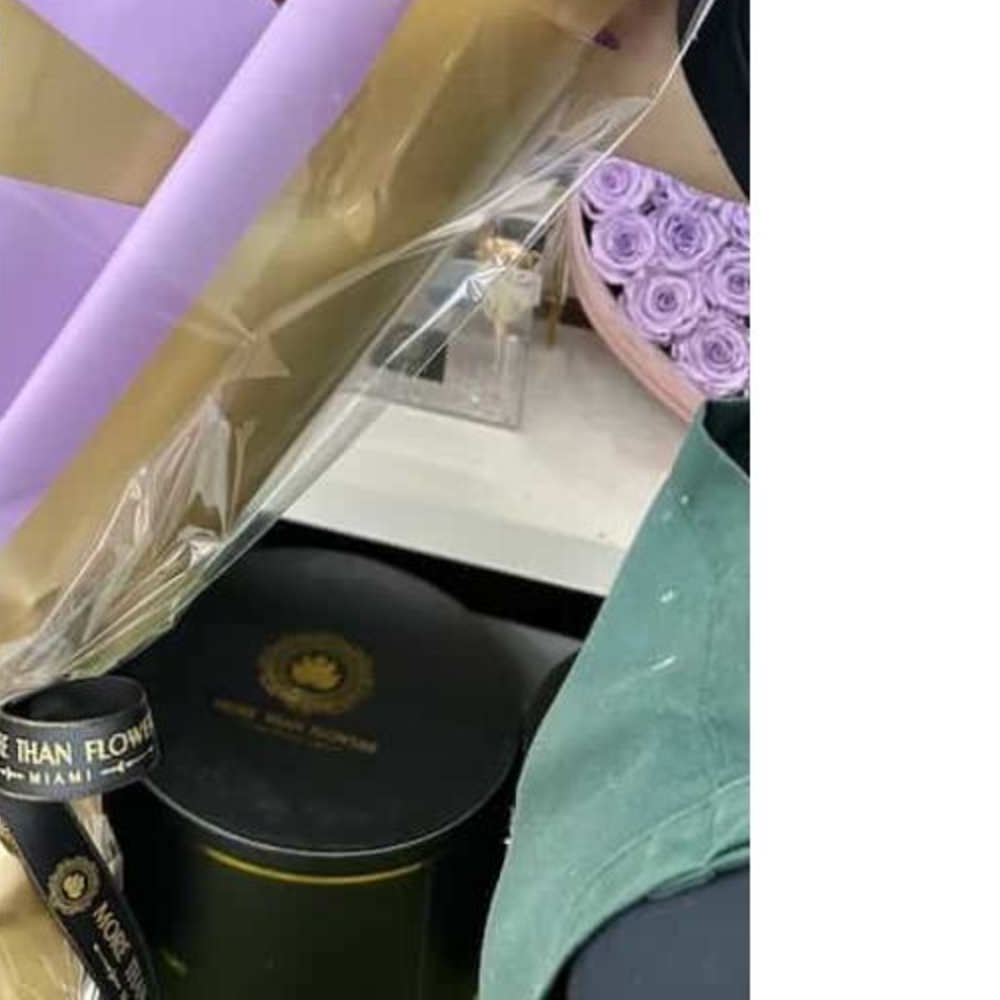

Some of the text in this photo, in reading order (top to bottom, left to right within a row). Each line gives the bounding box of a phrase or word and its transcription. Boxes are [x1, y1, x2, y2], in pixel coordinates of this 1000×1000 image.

[16, 738, 72, 766] THAN
[29, 768, 92, 785] MIAMI
[93, 902, 131, 962] MORE
